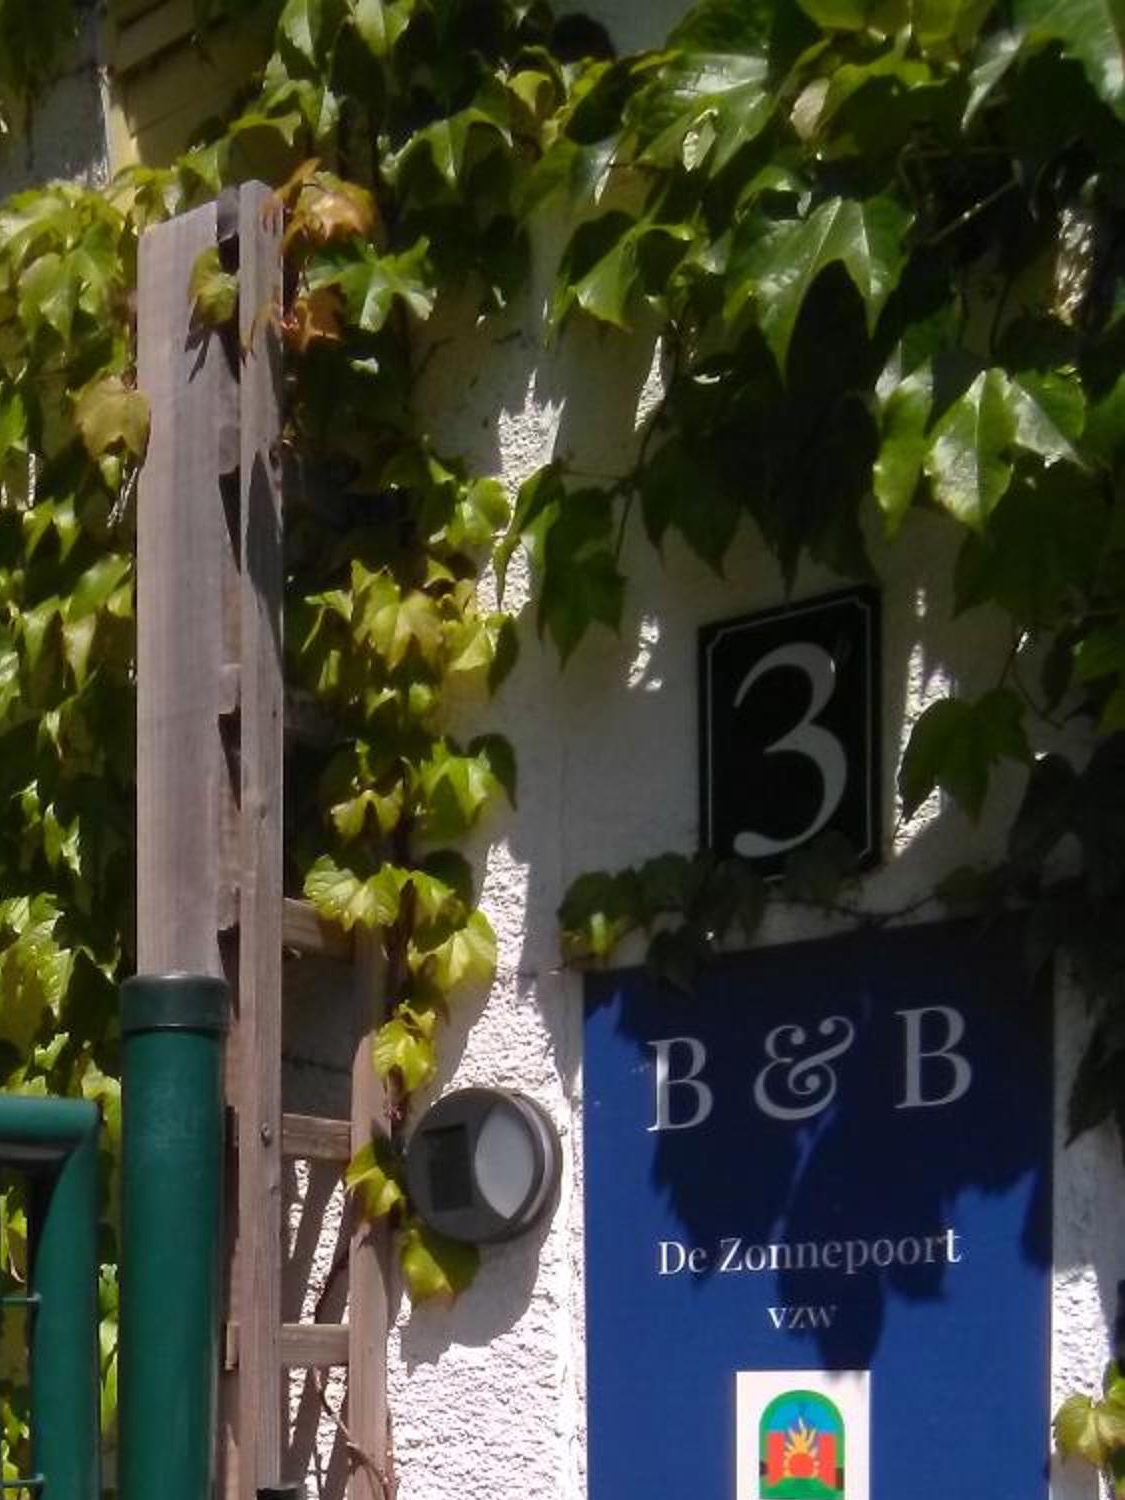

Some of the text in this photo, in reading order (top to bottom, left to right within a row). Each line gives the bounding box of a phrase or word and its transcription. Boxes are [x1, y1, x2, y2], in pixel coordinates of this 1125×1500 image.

[733, 643, 847, 857] 3
[647, 1005, 972, 1131] B & B
[658, 1228, 962, 1275] De Zonnepoort
[768, 1305, 837, 1329] vzw
